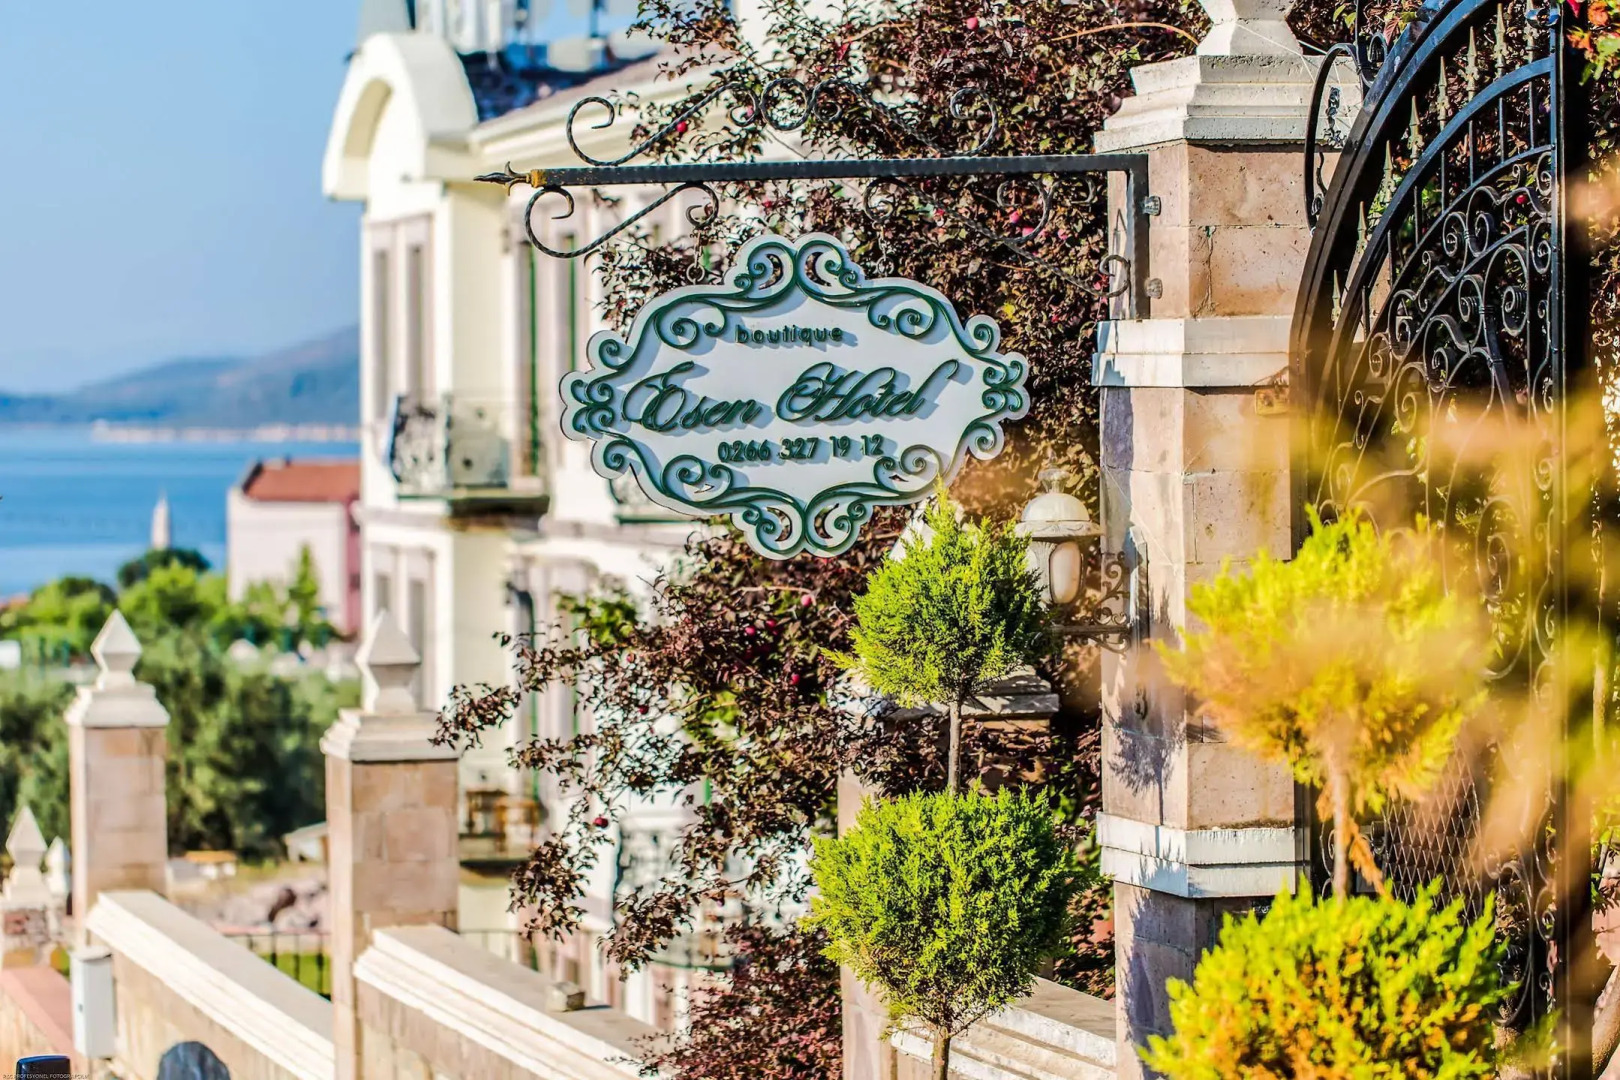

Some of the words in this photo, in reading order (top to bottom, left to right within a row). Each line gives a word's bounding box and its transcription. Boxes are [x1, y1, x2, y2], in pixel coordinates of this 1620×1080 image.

[735, 324, 843, 347] boutique
[621, 360, 763, 432] Esen
[776, 359, 959, 422] Hotel
[718, 439, 771, 462] 0266
[777, 437, 819, 460] 327
[829, 435, 851, 457] 19
[860, 434, 884, 456] 12
